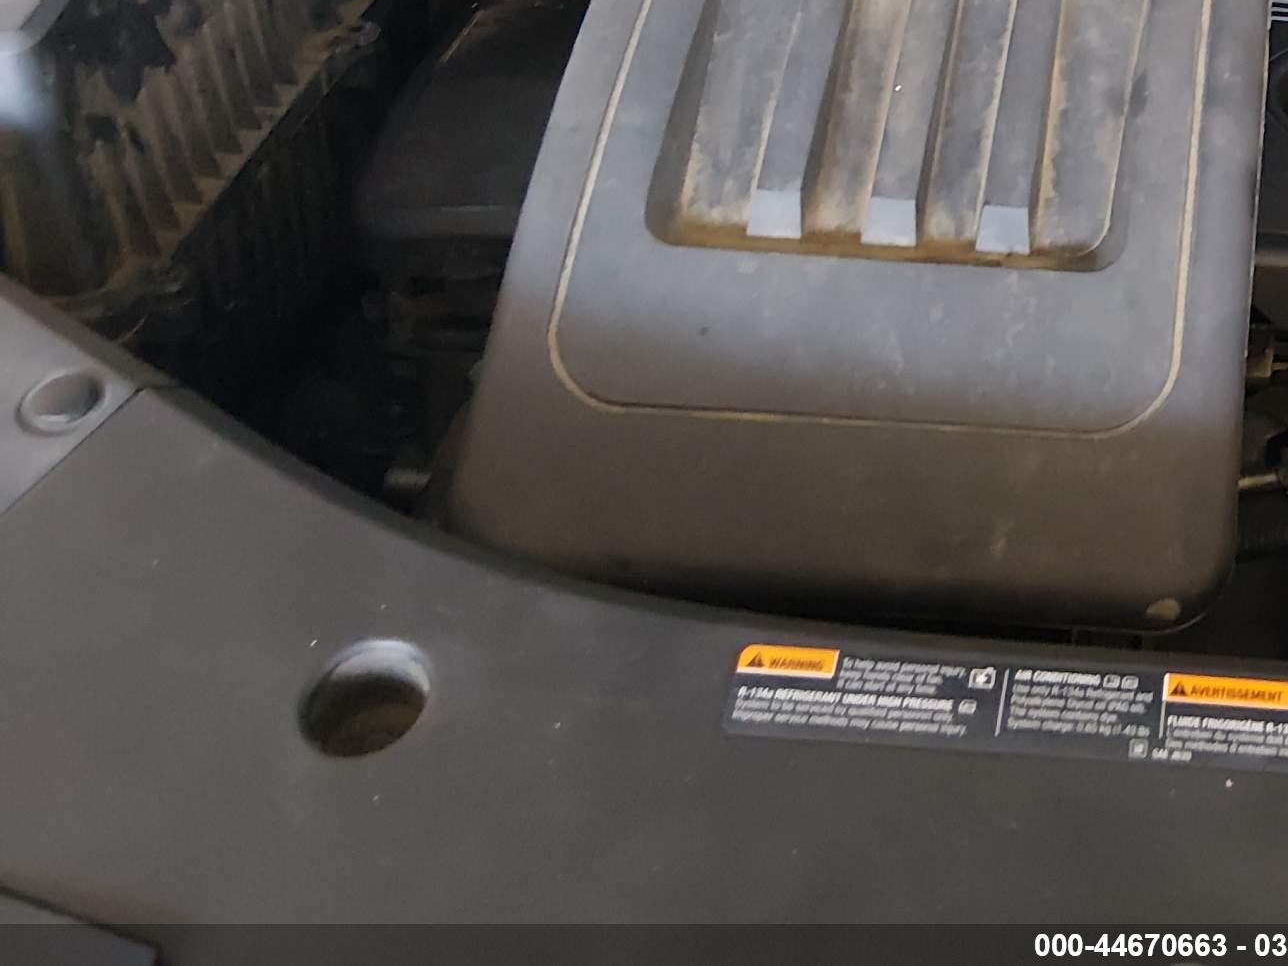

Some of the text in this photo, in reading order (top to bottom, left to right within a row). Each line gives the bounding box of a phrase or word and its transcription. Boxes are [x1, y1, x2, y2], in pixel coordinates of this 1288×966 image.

[769, 657, 825, 672] WARNING
[1033, 670, 1101, 687] CONDITIONING
[737, 686, 774, 699] R-134a
[774, 688, 842, 703] REFRIGERANT
[902, 697, 955, 712] PRESSURE
[1190, 684, 1283, 703] AVERTISSEMENT
